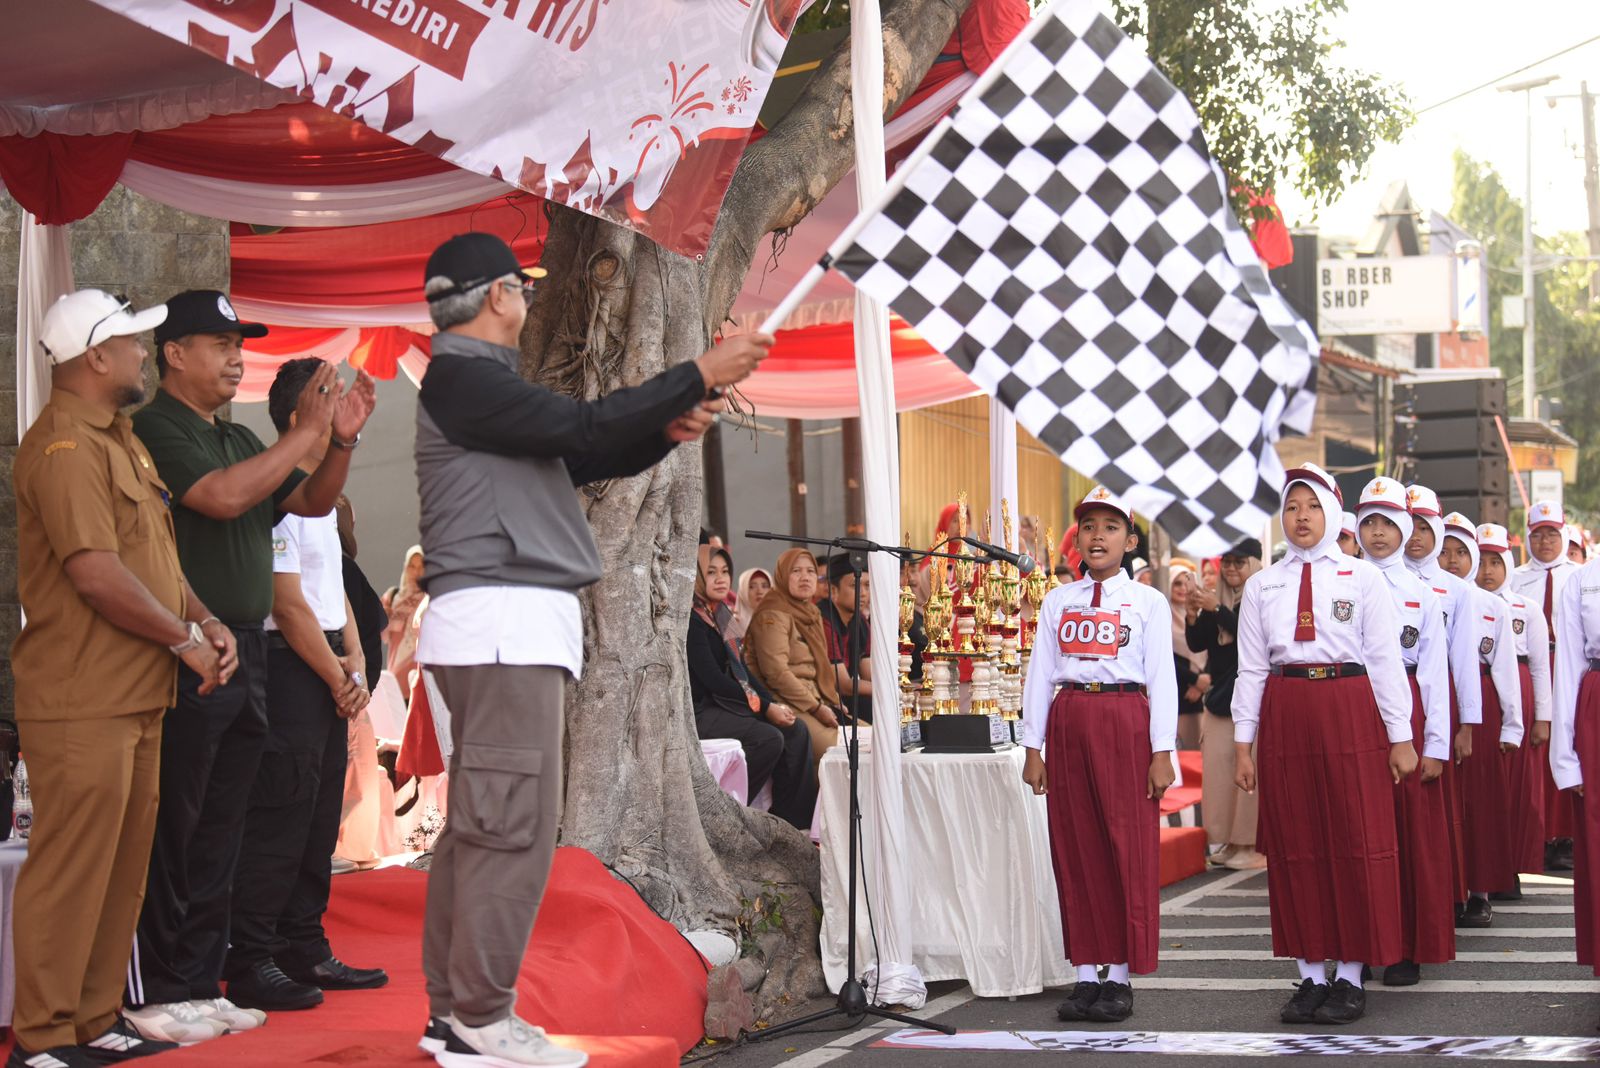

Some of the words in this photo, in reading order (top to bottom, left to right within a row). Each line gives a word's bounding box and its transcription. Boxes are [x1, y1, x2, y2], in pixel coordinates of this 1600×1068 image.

[1322, 267, 1392, 286] BRBER
[1322, 290, 1369, 308] SHOP
[1060, 619, 1116, 645] 008
